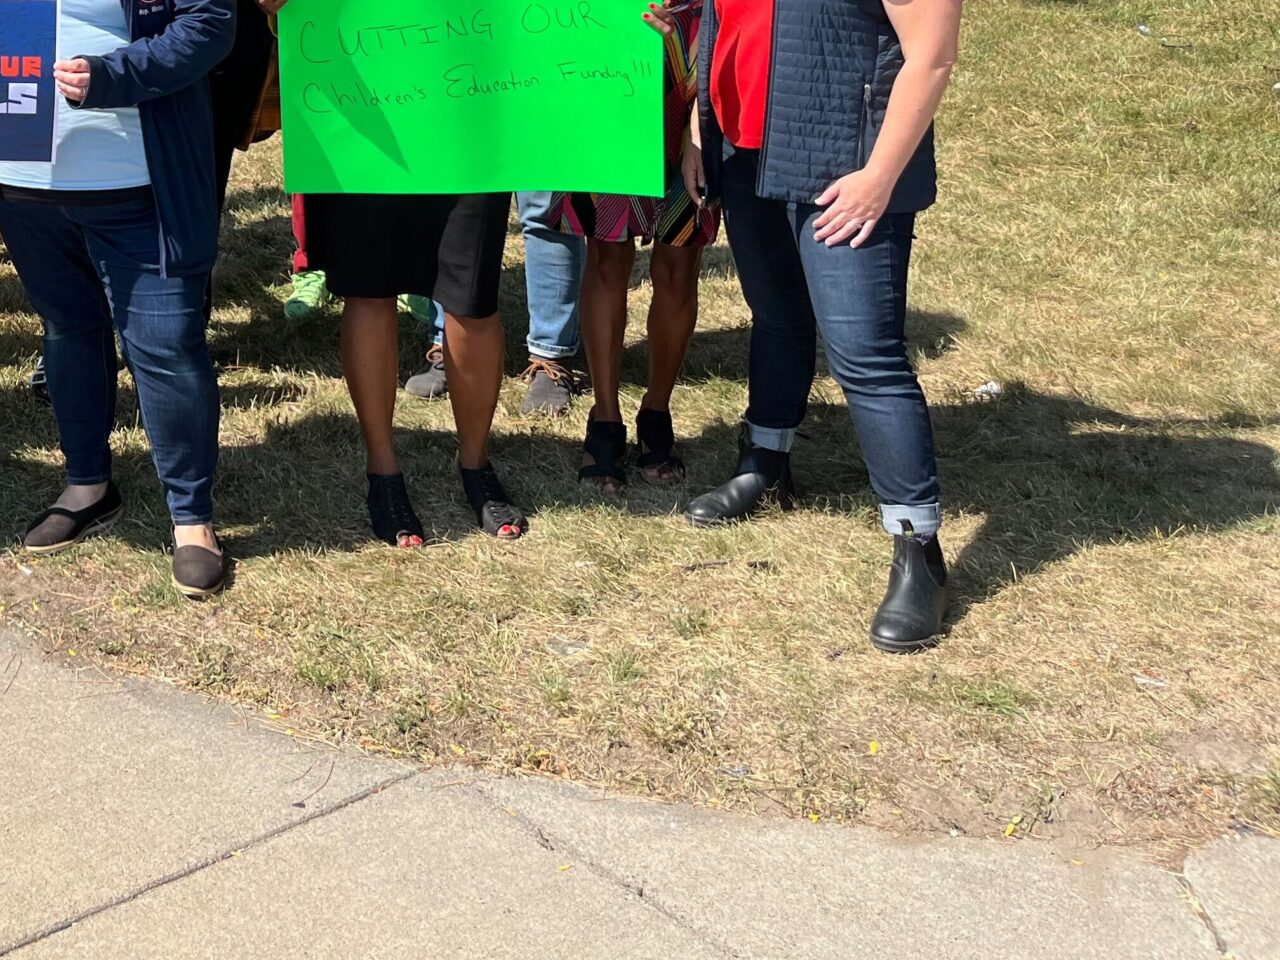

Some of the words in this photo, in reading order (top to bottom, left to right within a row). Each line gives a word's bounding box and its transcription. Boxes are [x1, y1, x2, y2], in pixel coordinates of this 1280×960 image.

[299, 9, 494, 64] CUTTING
[521, 0, 608, 34] OUR
[302, 82, 427, 113] Children's
[443, 63, 540, 98] Education
